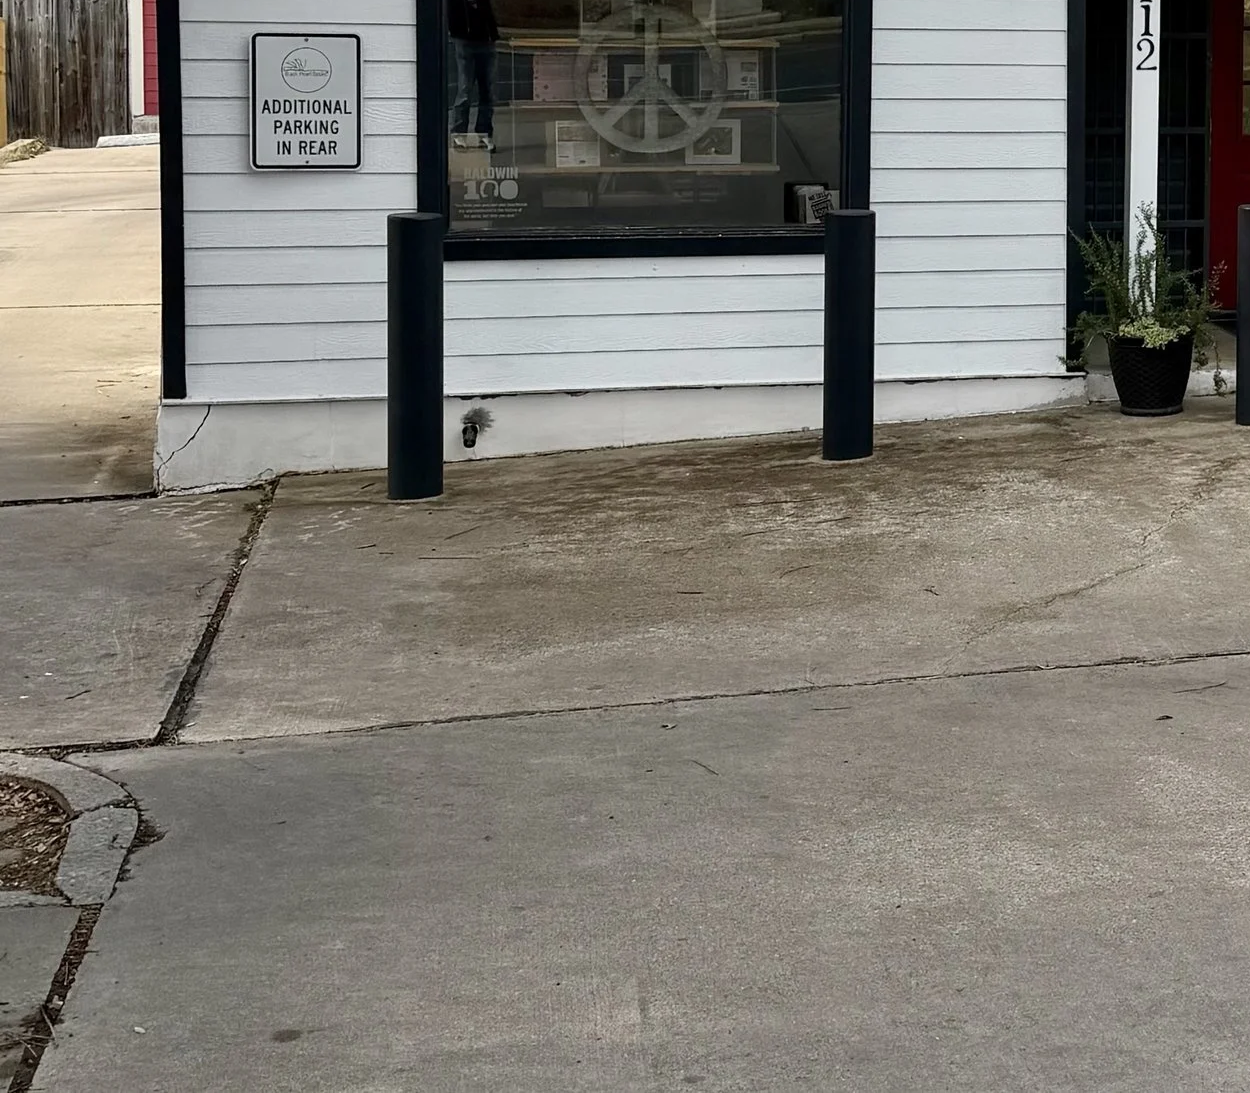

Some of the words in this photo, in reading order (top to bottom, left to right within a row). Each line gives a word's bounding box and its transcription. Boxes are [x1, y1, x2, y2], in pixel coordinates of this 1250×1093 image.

[261, 99, 352, 115] ADDITIONAL
[273, 120, 340, 135] PARKING
[276, 141, 291, 155] IN
[298, 141, 338, 155] REAR
[464, 167, 519, 180] BALDWIN
[463, 179, 519, 200] 100
